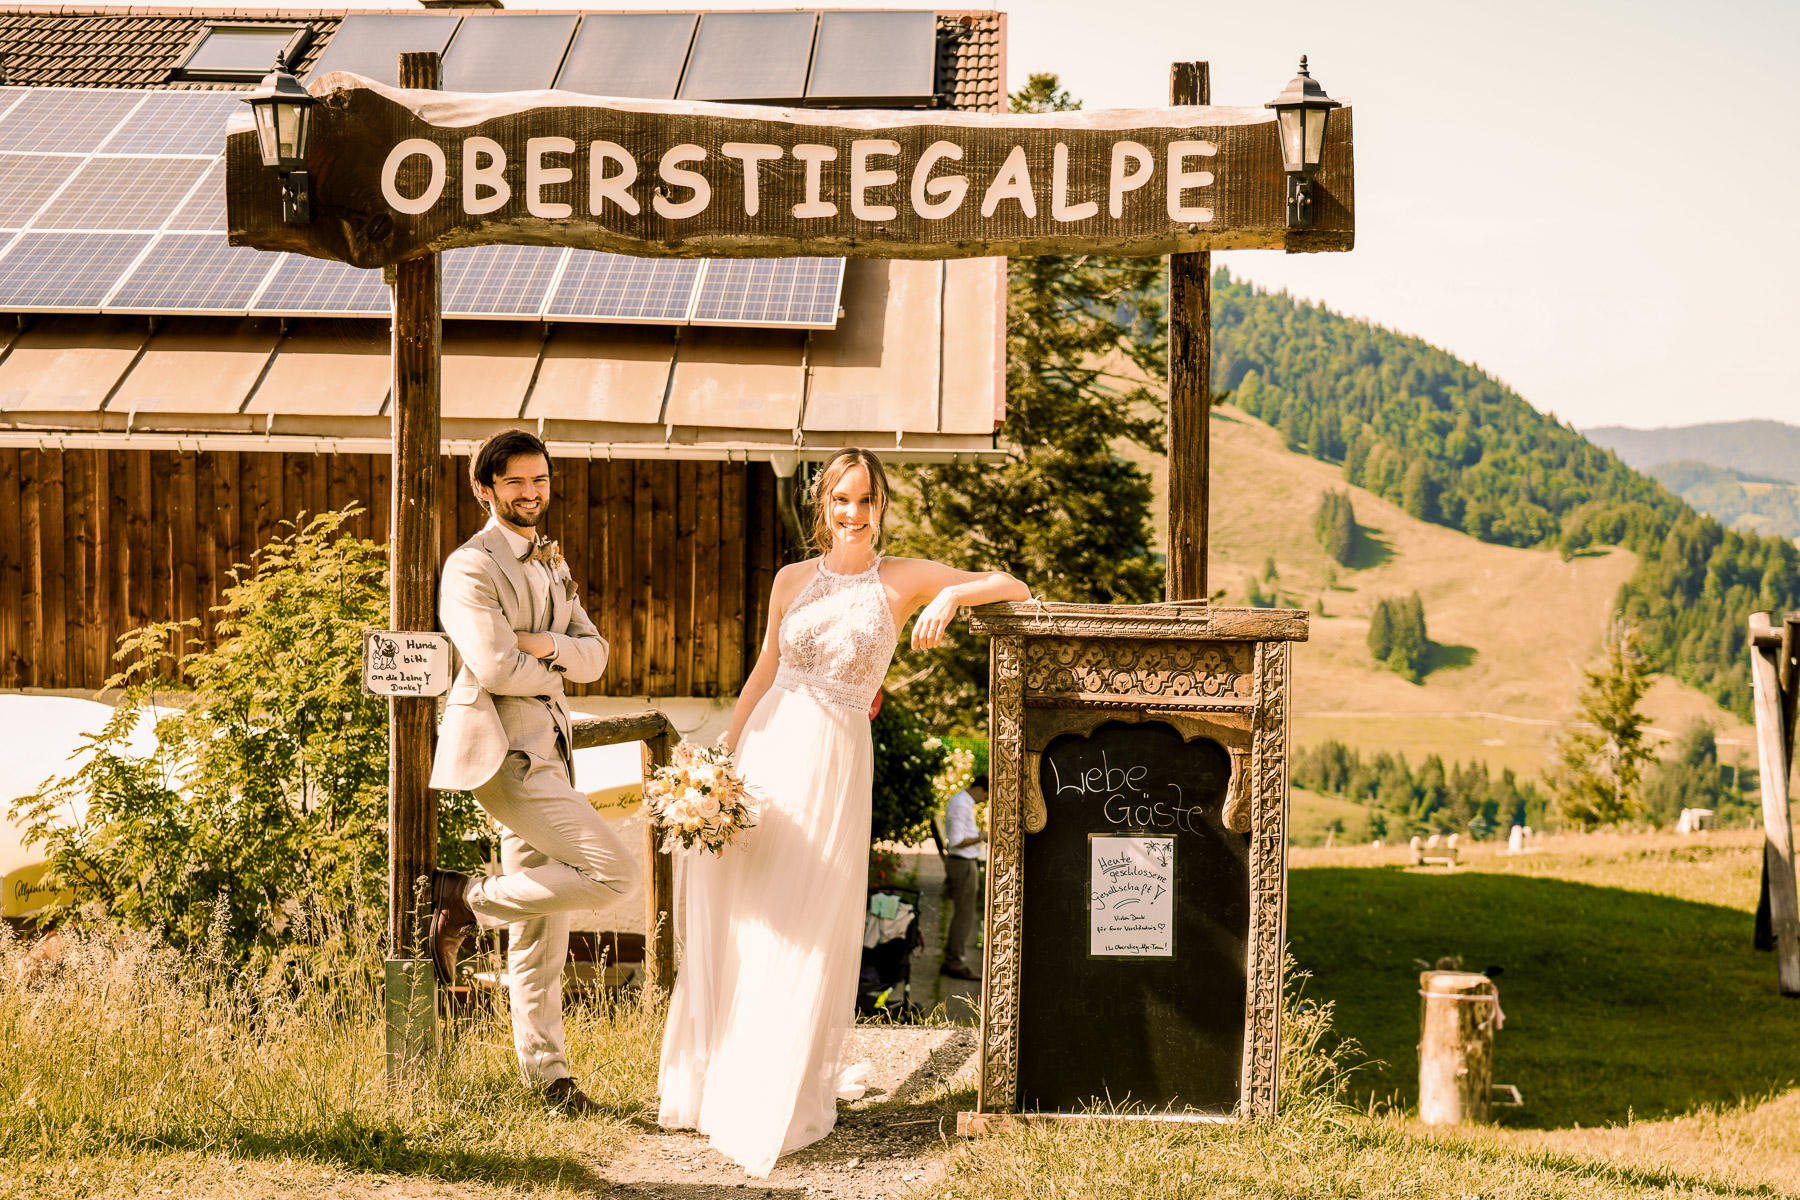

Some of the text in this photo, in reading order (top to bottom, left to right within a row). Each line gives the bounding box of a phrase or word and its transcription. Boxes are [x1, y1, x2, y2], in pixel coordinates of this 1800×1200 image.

[380, 136, 1219, 224] OBERSTIEGALPE
[406, 639, 438, 650] Hunde
[403, 655, 428, 664] bitte
[385, 673, 398, 681] die
[1048, 750, 1148, 796] Liebe
[1103, 783, 1206, 838] Gäste
[1097, 851, 1133, 870] Heute
[1109, 865, 1167, 884] geschlossene
[1129, 913, 1146, 922] Dank
[1096, 926, 1107, 934] für
[1124, 924, 1157, 932] Verständnis
